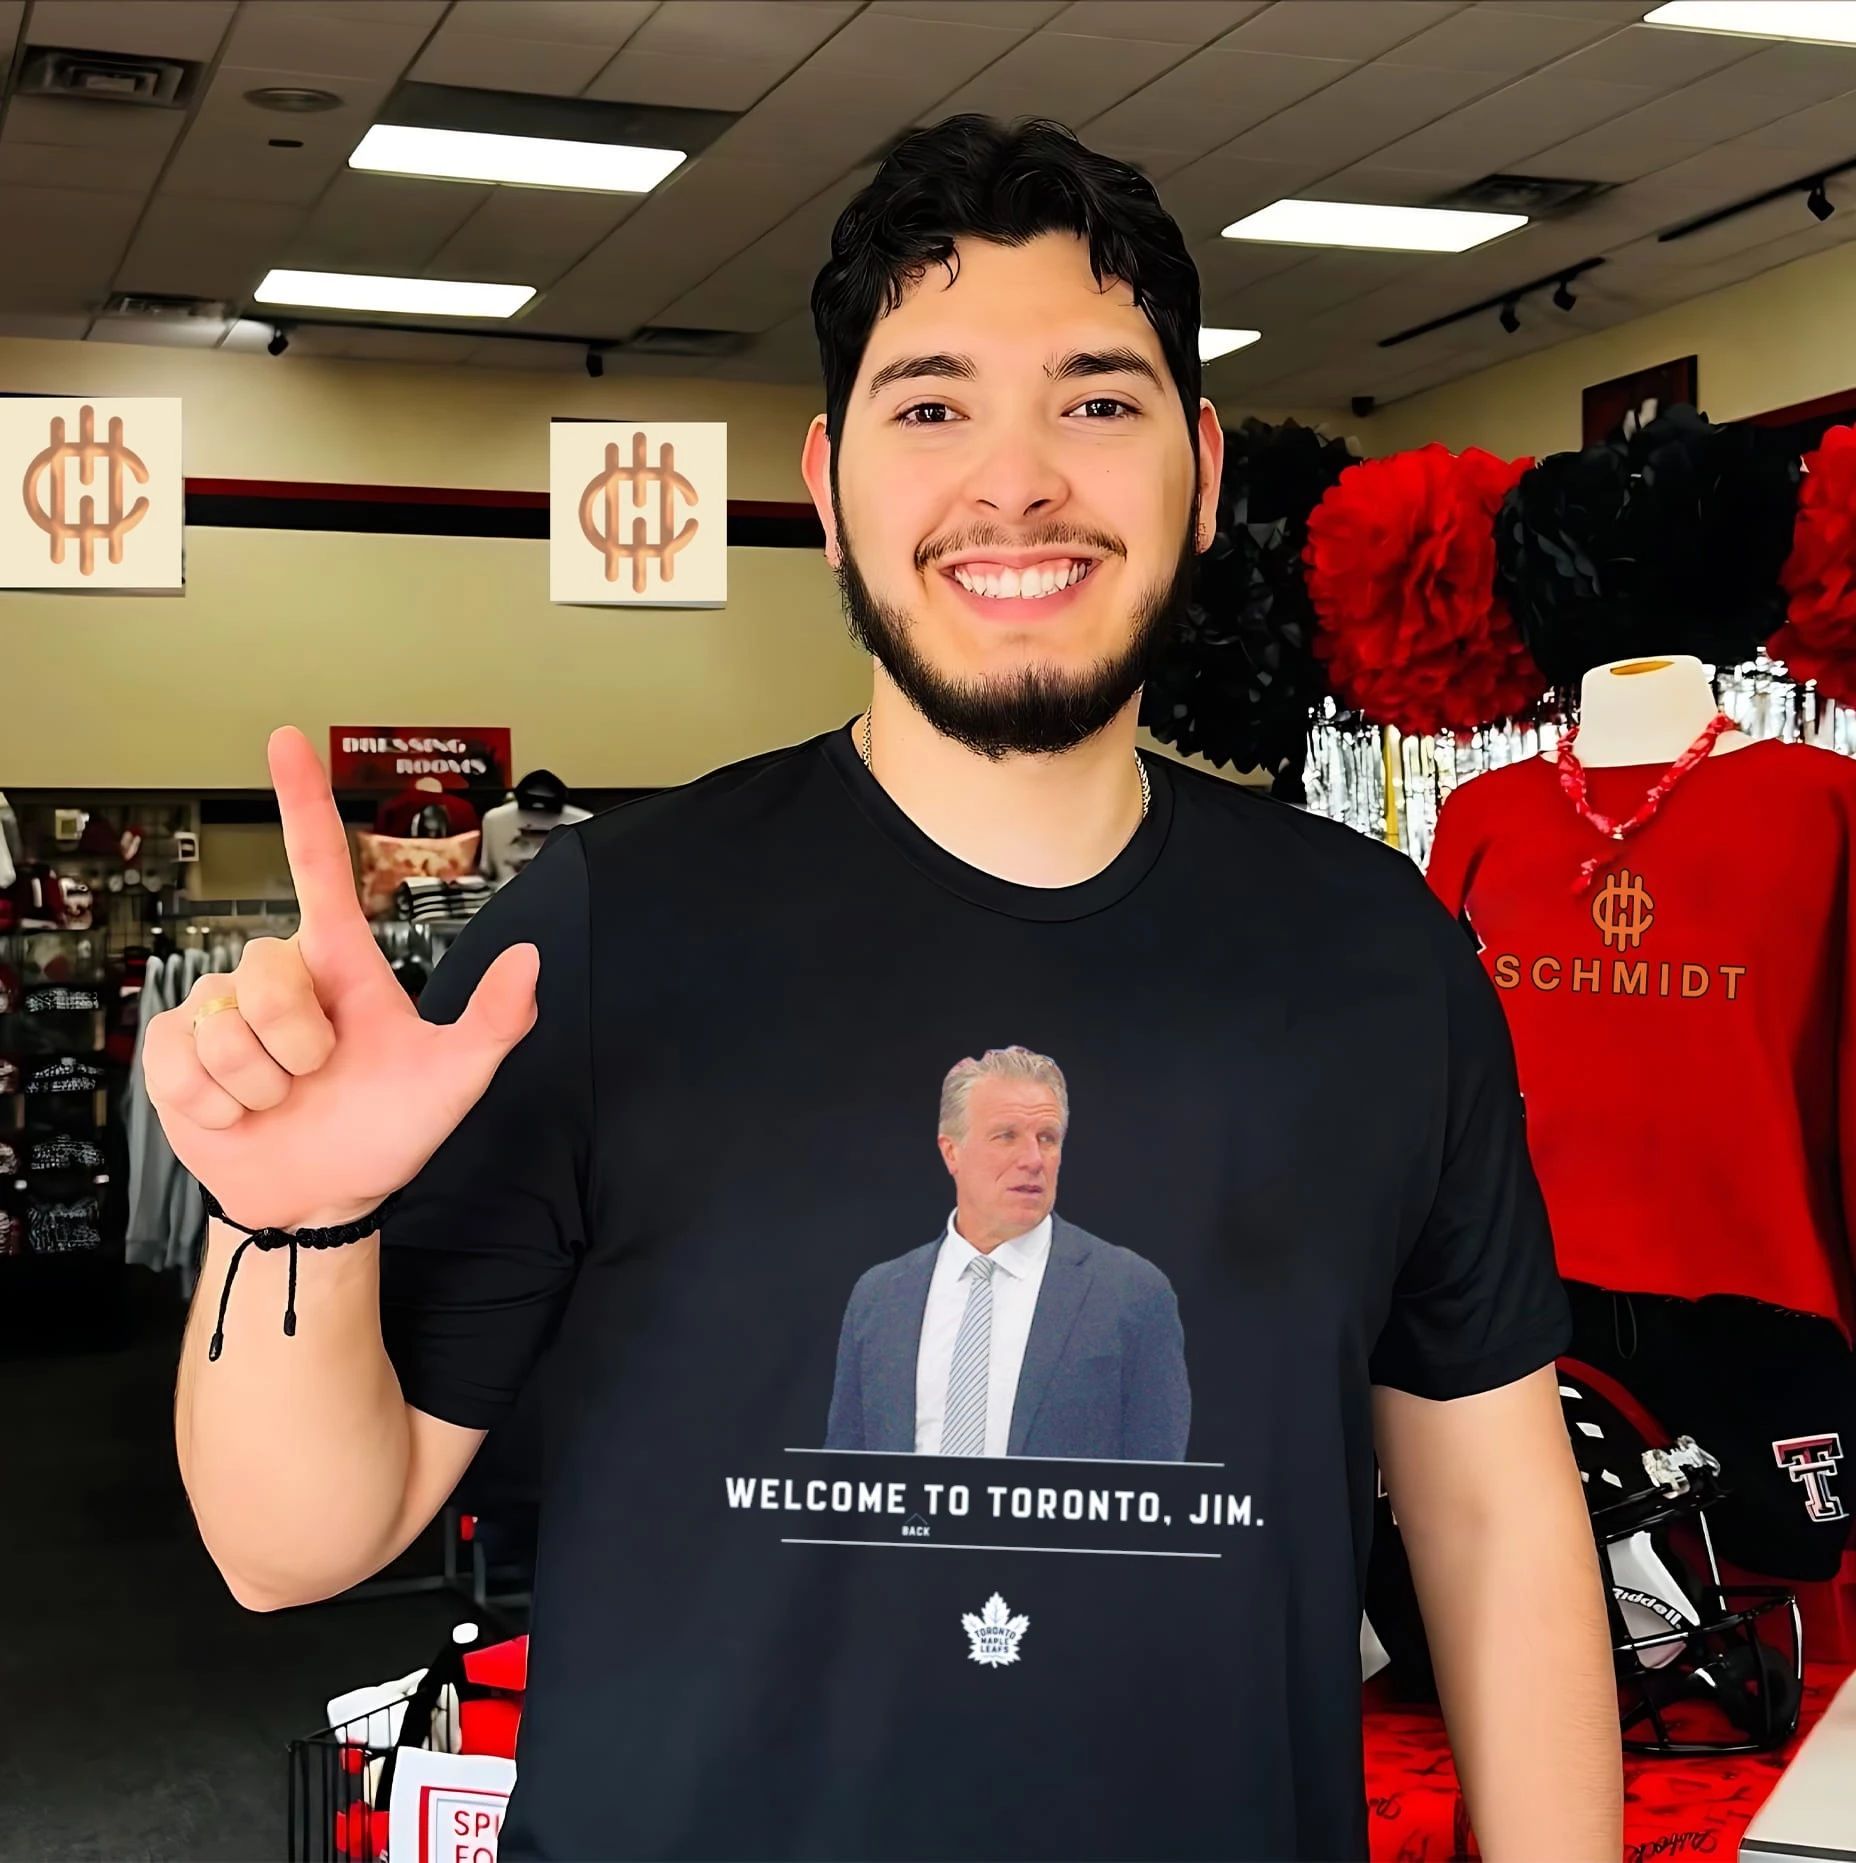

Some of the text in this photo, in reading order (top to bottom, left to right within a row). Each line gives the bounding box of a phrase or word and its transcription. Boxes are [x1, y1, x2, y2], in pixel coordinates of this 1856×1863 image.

[396, 758, 487, 774] ROOMS
[1494, 954, 1747, 1000] SCHMIDT
[725, 1477, 1264, 1527] WELCOME TO TORONTO, JIM.
[901, 1525, 931, 1537] BACK
[974, 1626, 1016, 1639] TORONTO
[981, 1637, 1009, 1645] MAPLE
[980, 1645, 1009, 1653] LEAFS
